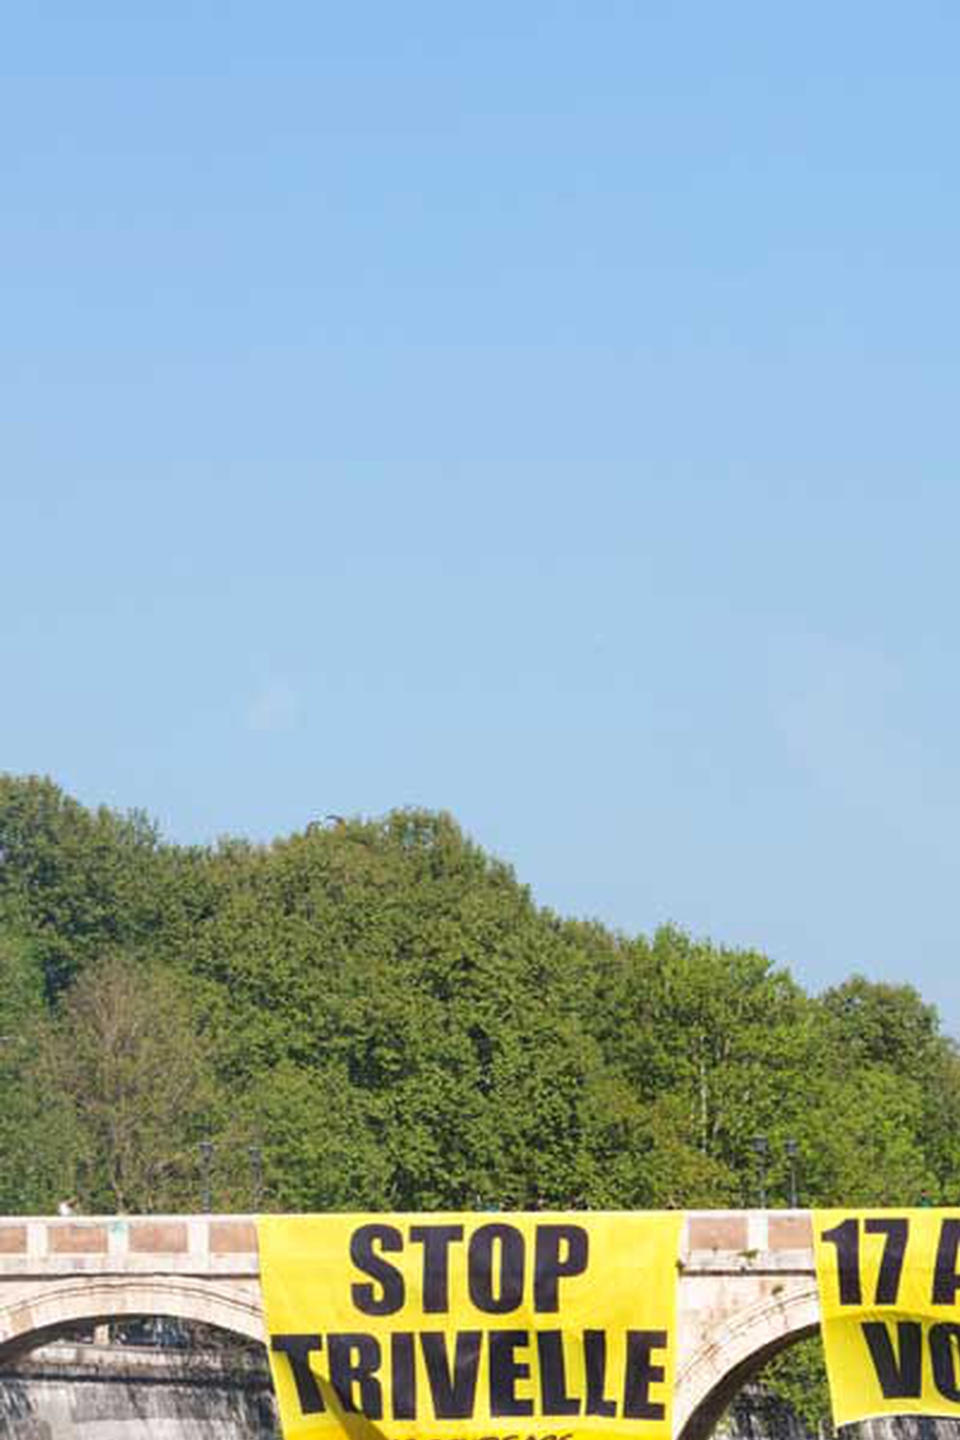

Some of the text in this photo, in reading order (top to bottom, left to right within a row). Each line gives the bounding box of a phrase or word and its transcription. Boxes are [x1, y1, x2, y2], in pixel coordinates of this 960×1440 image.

[350, 1223, 590, 1317] STOP
[820, 1217, 910, 1306] 17
[271, 1328, 669, 1421] TRIVELLE
